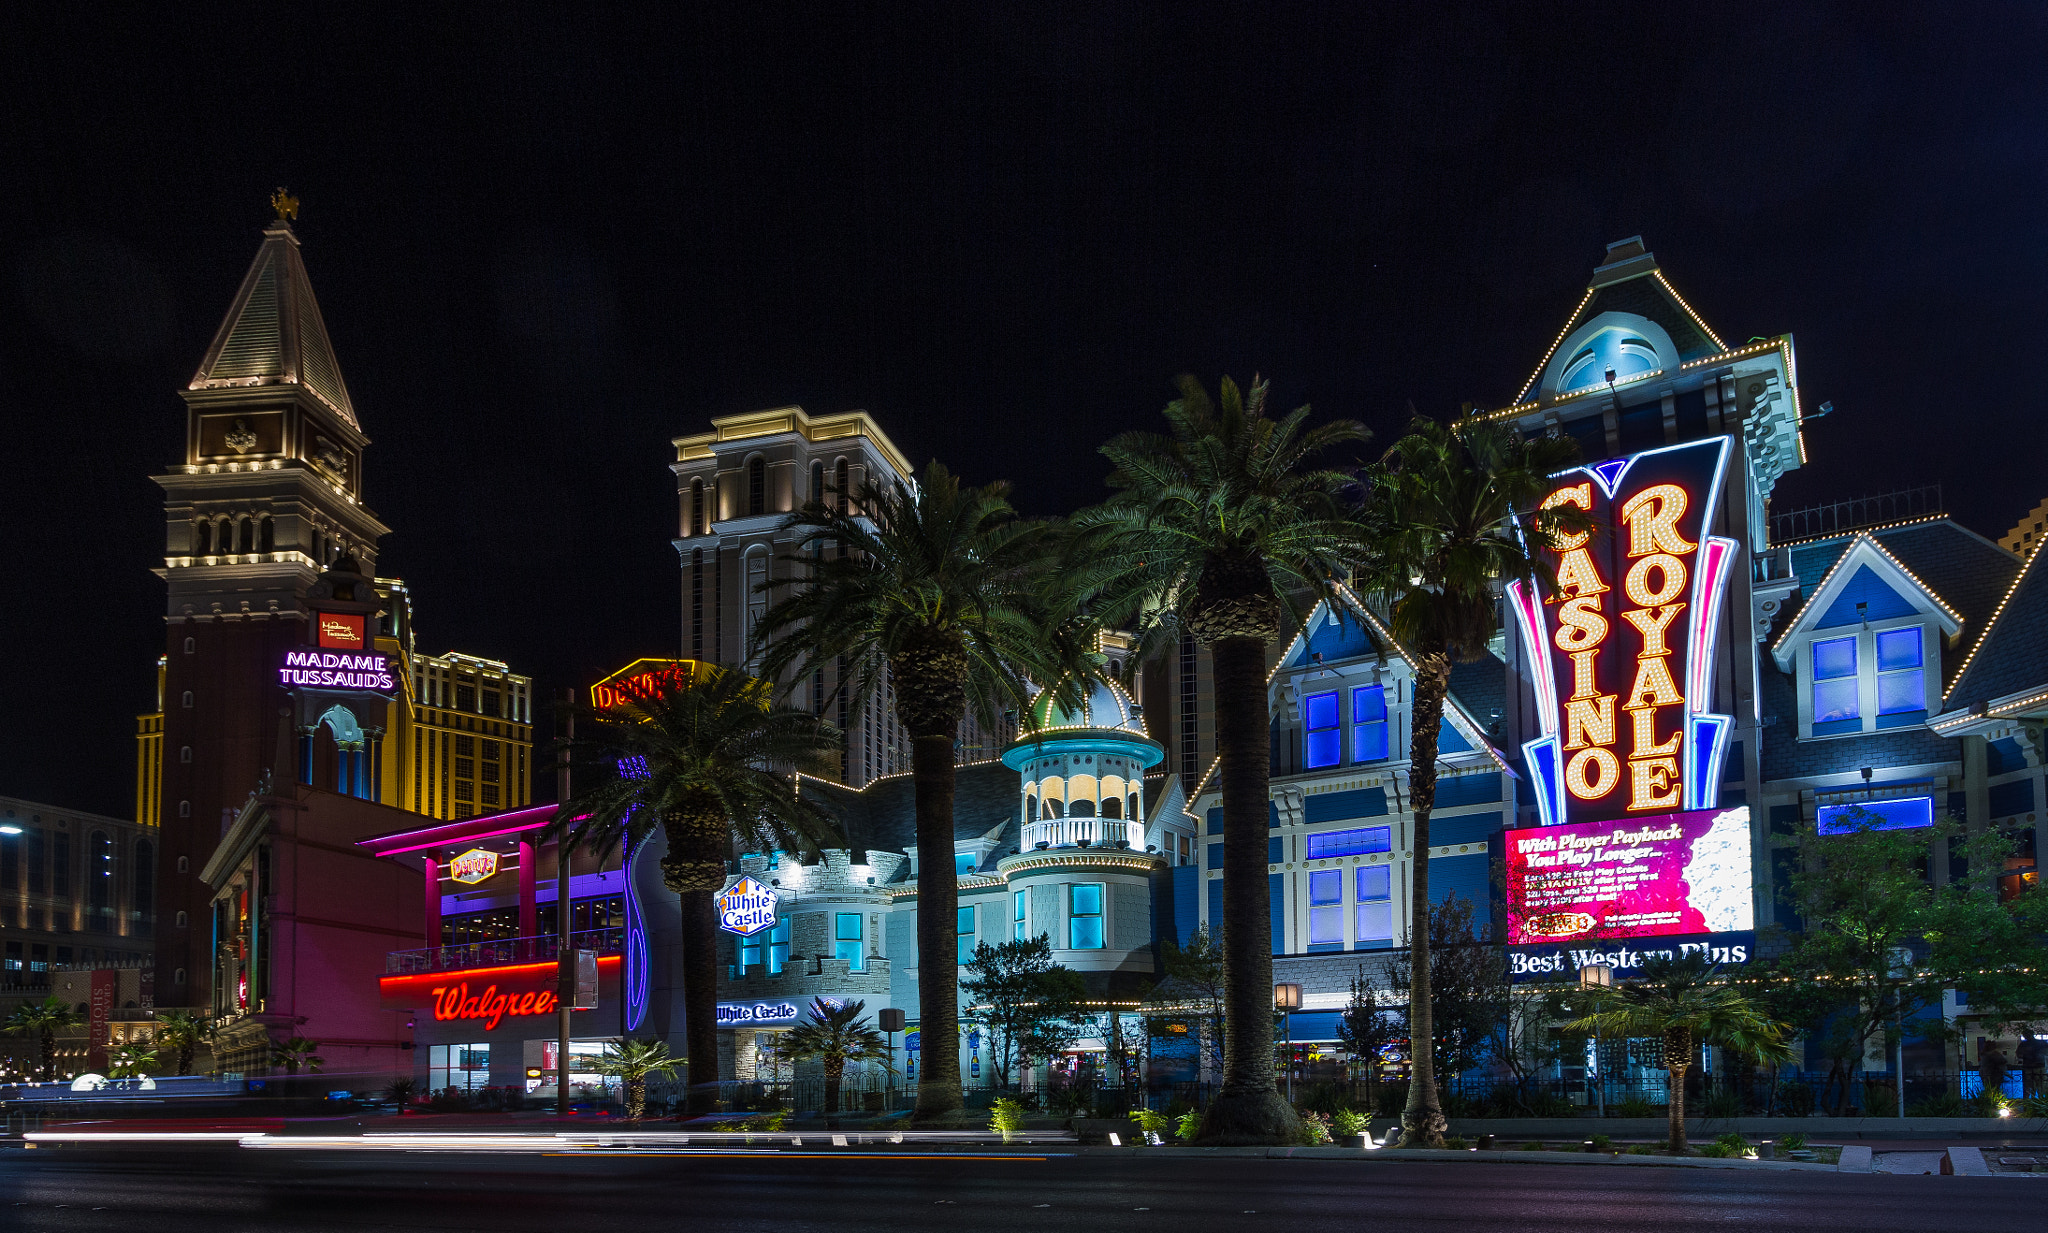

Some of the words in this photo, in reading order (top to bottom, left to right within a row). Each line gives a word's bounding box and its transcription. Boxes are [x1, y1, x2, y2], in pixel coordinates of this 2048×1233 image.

[322, 621, 352, 631] Madame
[1536, 483, 1620, 799] CASINO
[1622, 484, 1698, 811] ROYALE
[286, 651, 387, 671] MADAME
[279, 668, 393, 689] TUSSAUD'S
[1517, 837, 1557, 854] With
[1558, 833, 1611, 852] Player
[1611, 823, 1683, 847] Payback
[1525, 852, 1556, 869] You
[1558, 850, 1593, 867] Play
[1574, 869, 1593, 878] Free
[1595, 868, 1615, 877] Play
[1616, 865, 1649, 874] Credits
[1594, 875, 1616, 885] after
[1617, 874, 1638, 884] your
[1639, 872, 1659, 881] first
[1624, 882, 1639, 891] for
[726, 893, 770, 912] White
[722, 908, 773, 927] Castle
[1509, 950, 1565, 974] Best
[1678, 942, 1747, 965] Plus
[431, 982, 560, 1031] Walgree
[717, 1005, 751, 1022] White
[752, 1004, 795, 1019] Castle
